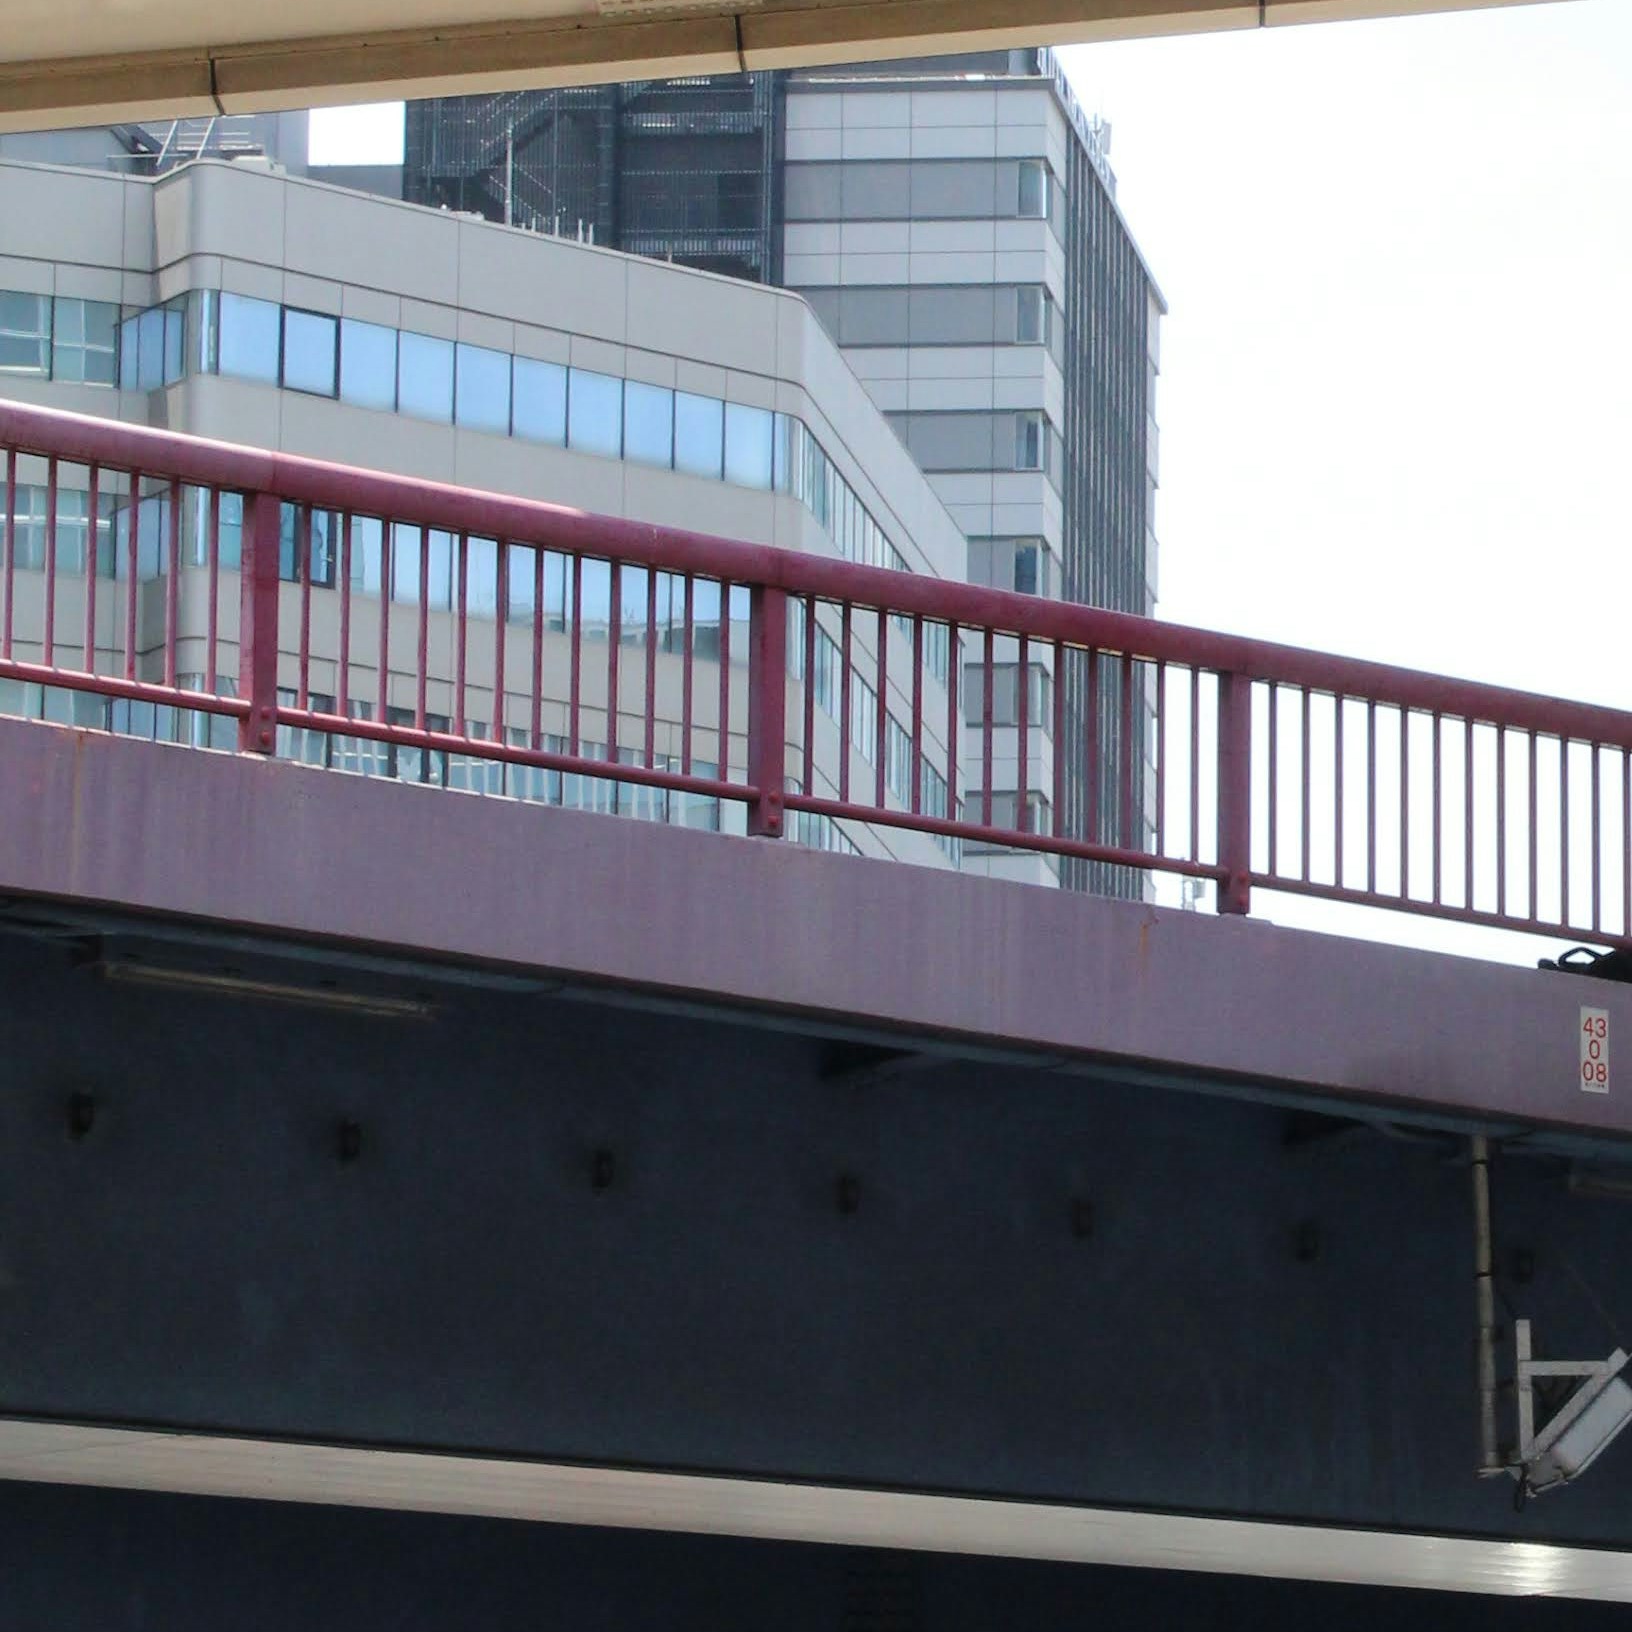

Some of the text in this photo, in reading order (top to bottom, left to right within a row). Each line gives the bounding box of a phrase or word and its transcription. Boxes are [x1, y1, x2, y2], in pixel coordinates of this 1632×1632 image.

[1583, 1017, 1606, 1038] 43
[1589, 1039, 1600, 1059] 0
[1583, 1061, 1607, 1082] 08
